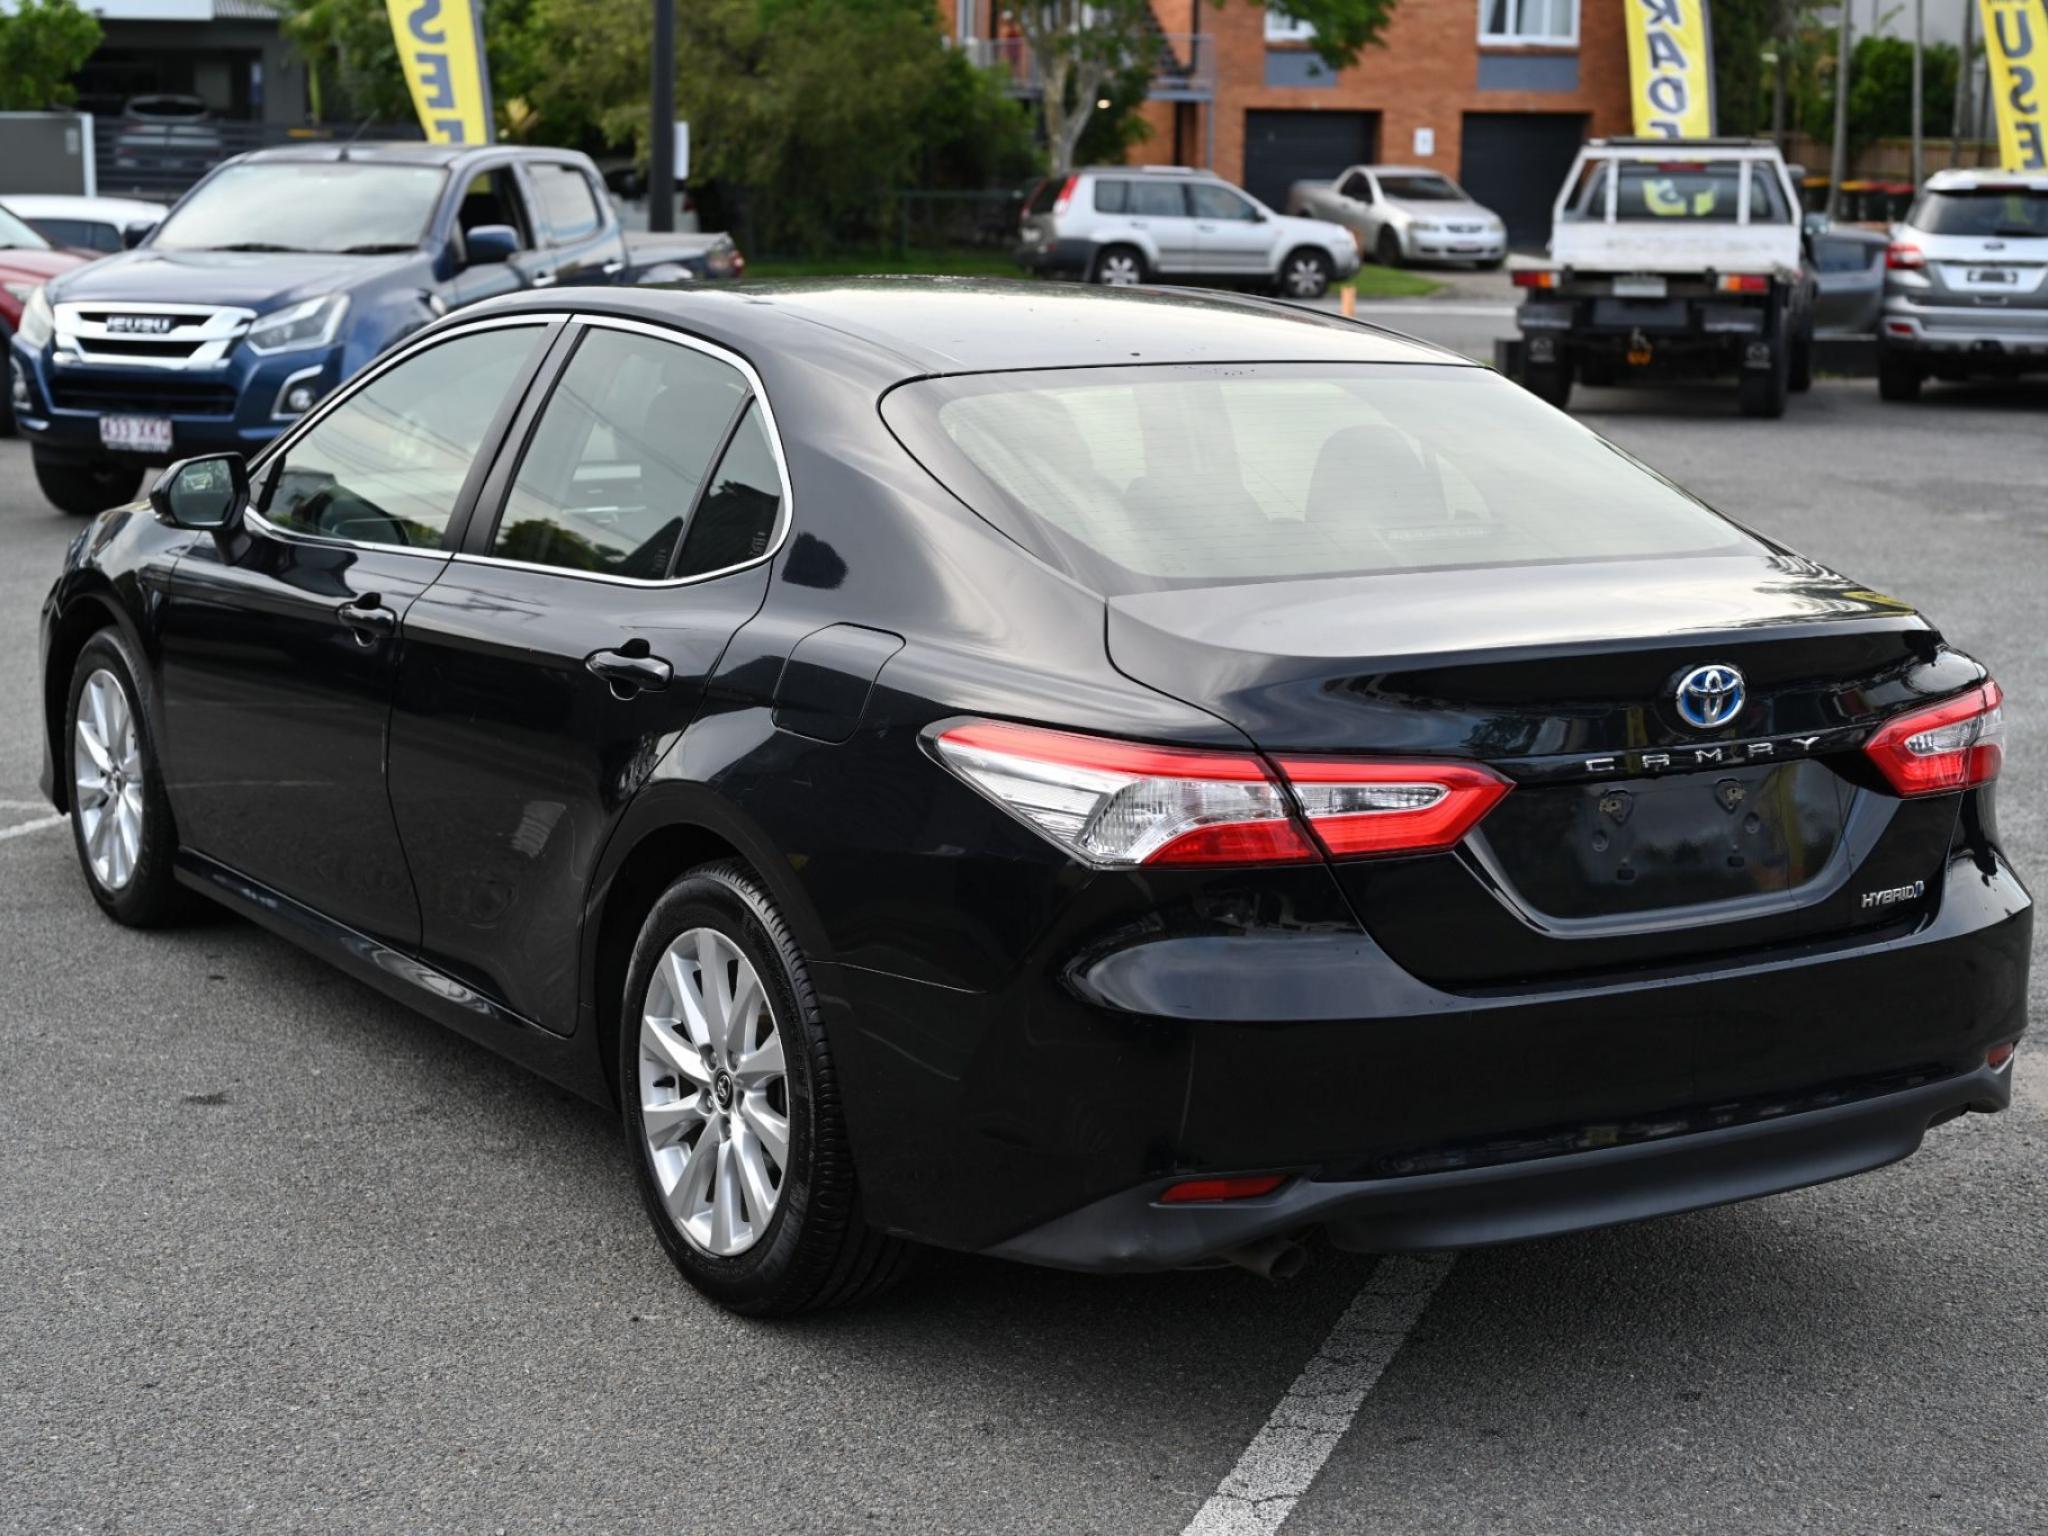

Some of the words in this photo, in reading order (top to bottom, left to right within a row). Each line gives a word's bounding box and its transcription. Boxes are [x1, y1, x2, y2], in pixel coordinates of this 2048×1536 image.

[106, 315, 170, 333] ISUZU
[1585, 736, 1820, 772] CAMRY
[1861, 885, 1915, 909] HYBRID
